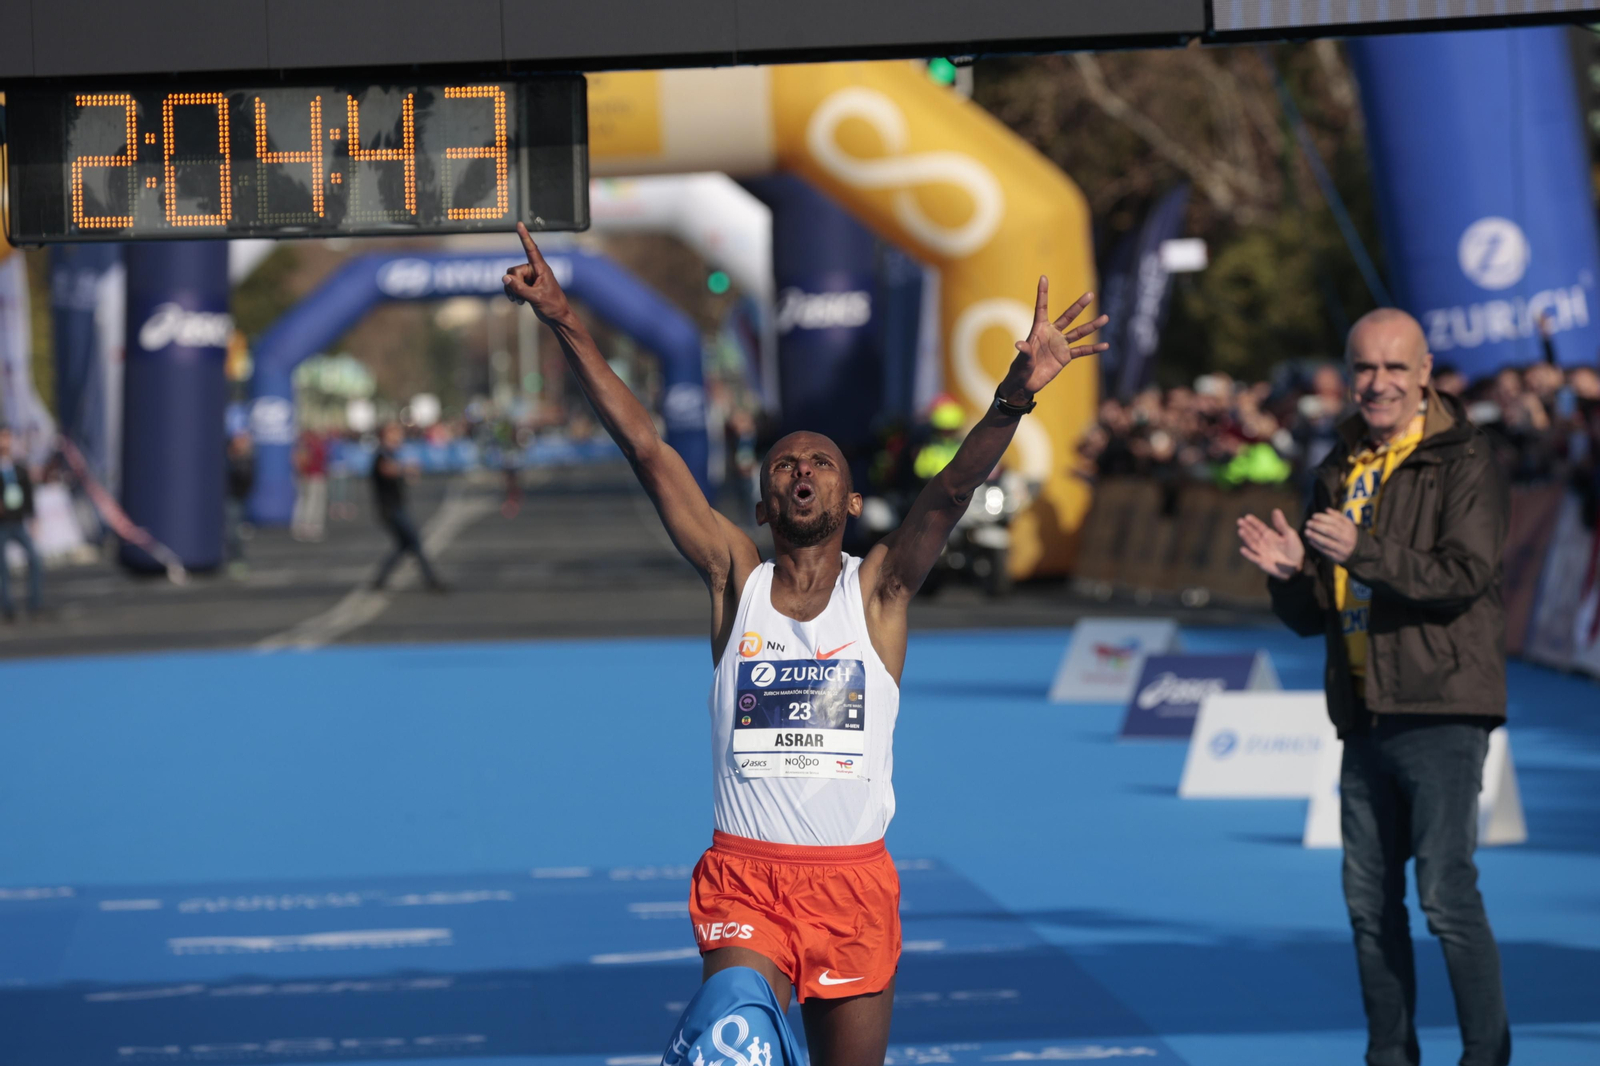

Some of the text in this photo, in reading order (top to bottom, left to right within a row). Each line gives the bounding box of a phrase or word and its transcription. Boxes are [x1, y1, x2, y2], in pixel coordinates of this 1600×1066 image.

[1424, 285, 1589, 351] ZURICH
[766, 640, 785, 652] NN
[780, 666, 850, 682] ZURICH
[788, 702, 811, 720] 23
[774, 733, 824, 747] ASRAR
